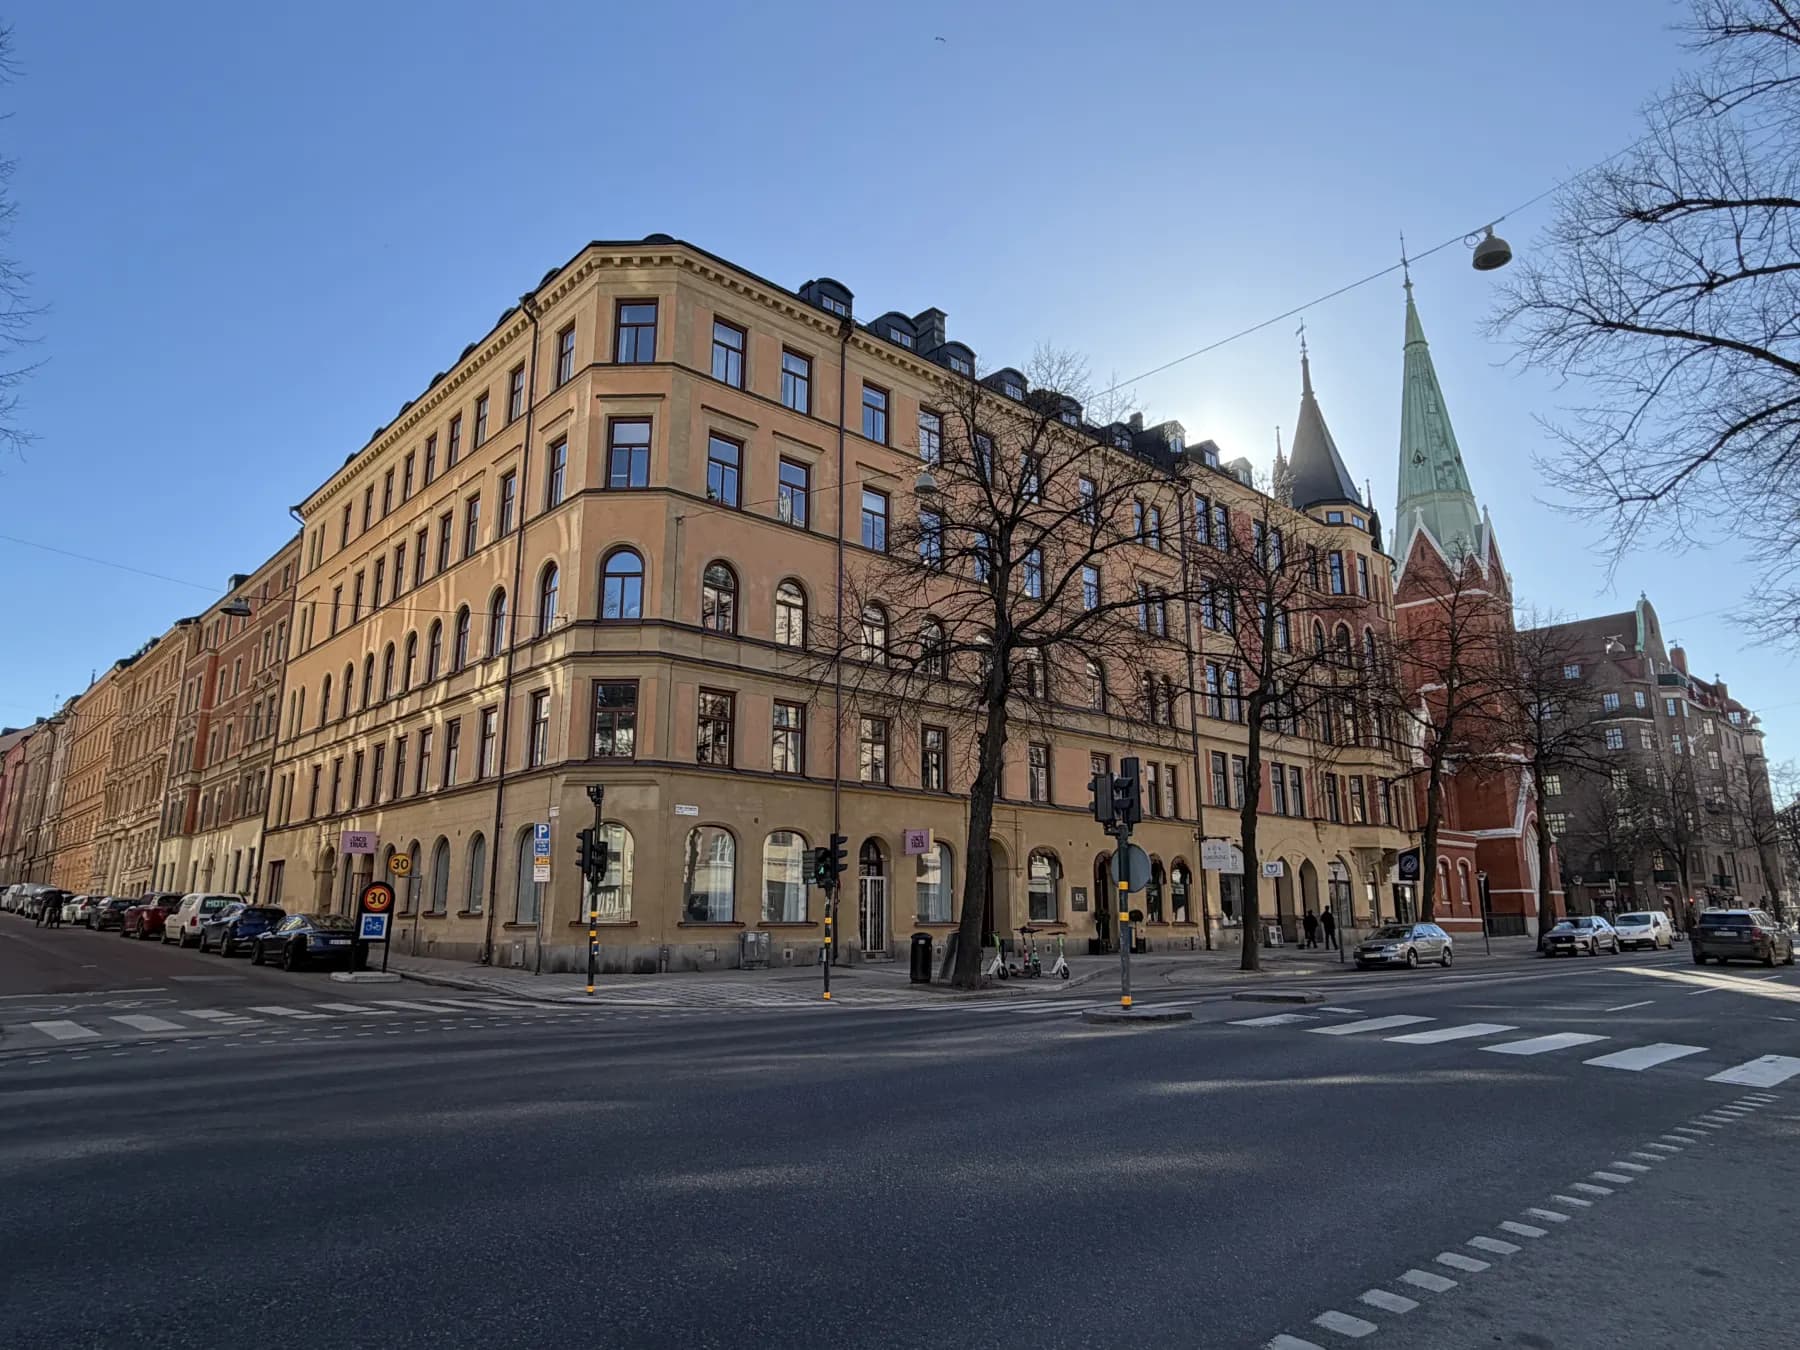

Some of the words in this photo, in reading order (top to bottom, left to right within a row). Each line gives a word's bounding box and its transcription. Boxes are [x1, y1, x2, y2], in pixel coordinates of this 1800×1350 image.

[538, 825, 548, 838] P
[392, 859, 409, 870] 30
[368, 892, 387, 905] 30
